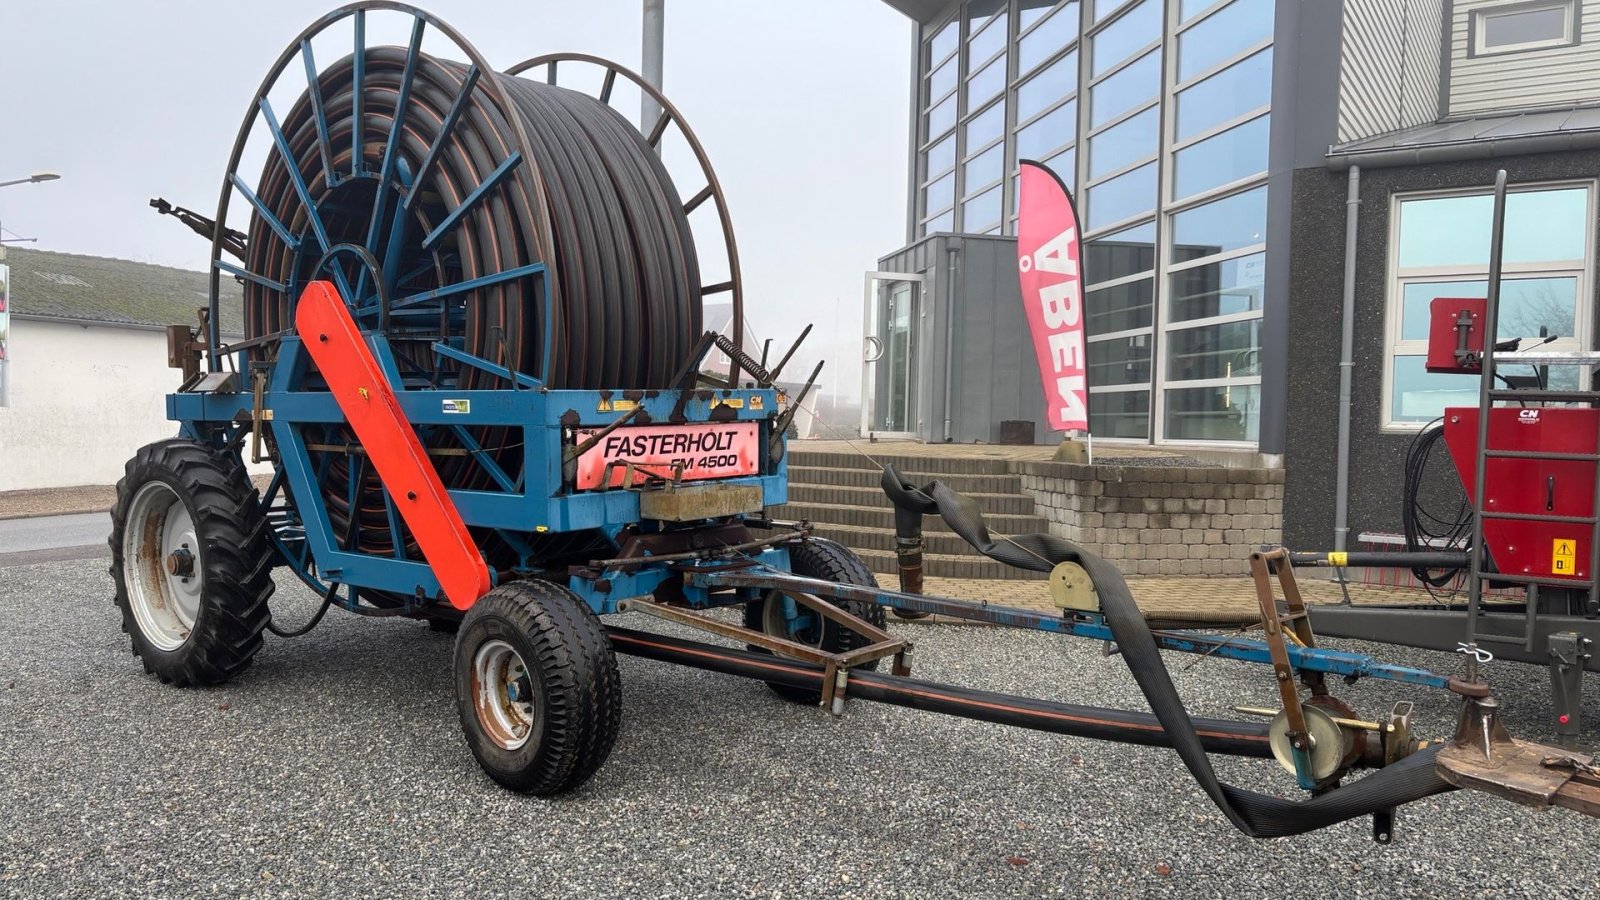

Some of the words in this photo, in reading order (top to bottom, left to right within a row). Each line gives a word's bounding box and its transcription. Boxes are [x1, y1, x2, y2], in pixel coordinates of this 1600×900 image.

[1520, 409, 1539, 418] CN
[604, 431, 738, 458] FASTERHOLT
[670, 457, 694, 471] FM
[698, 455, 737, 468] 4500
